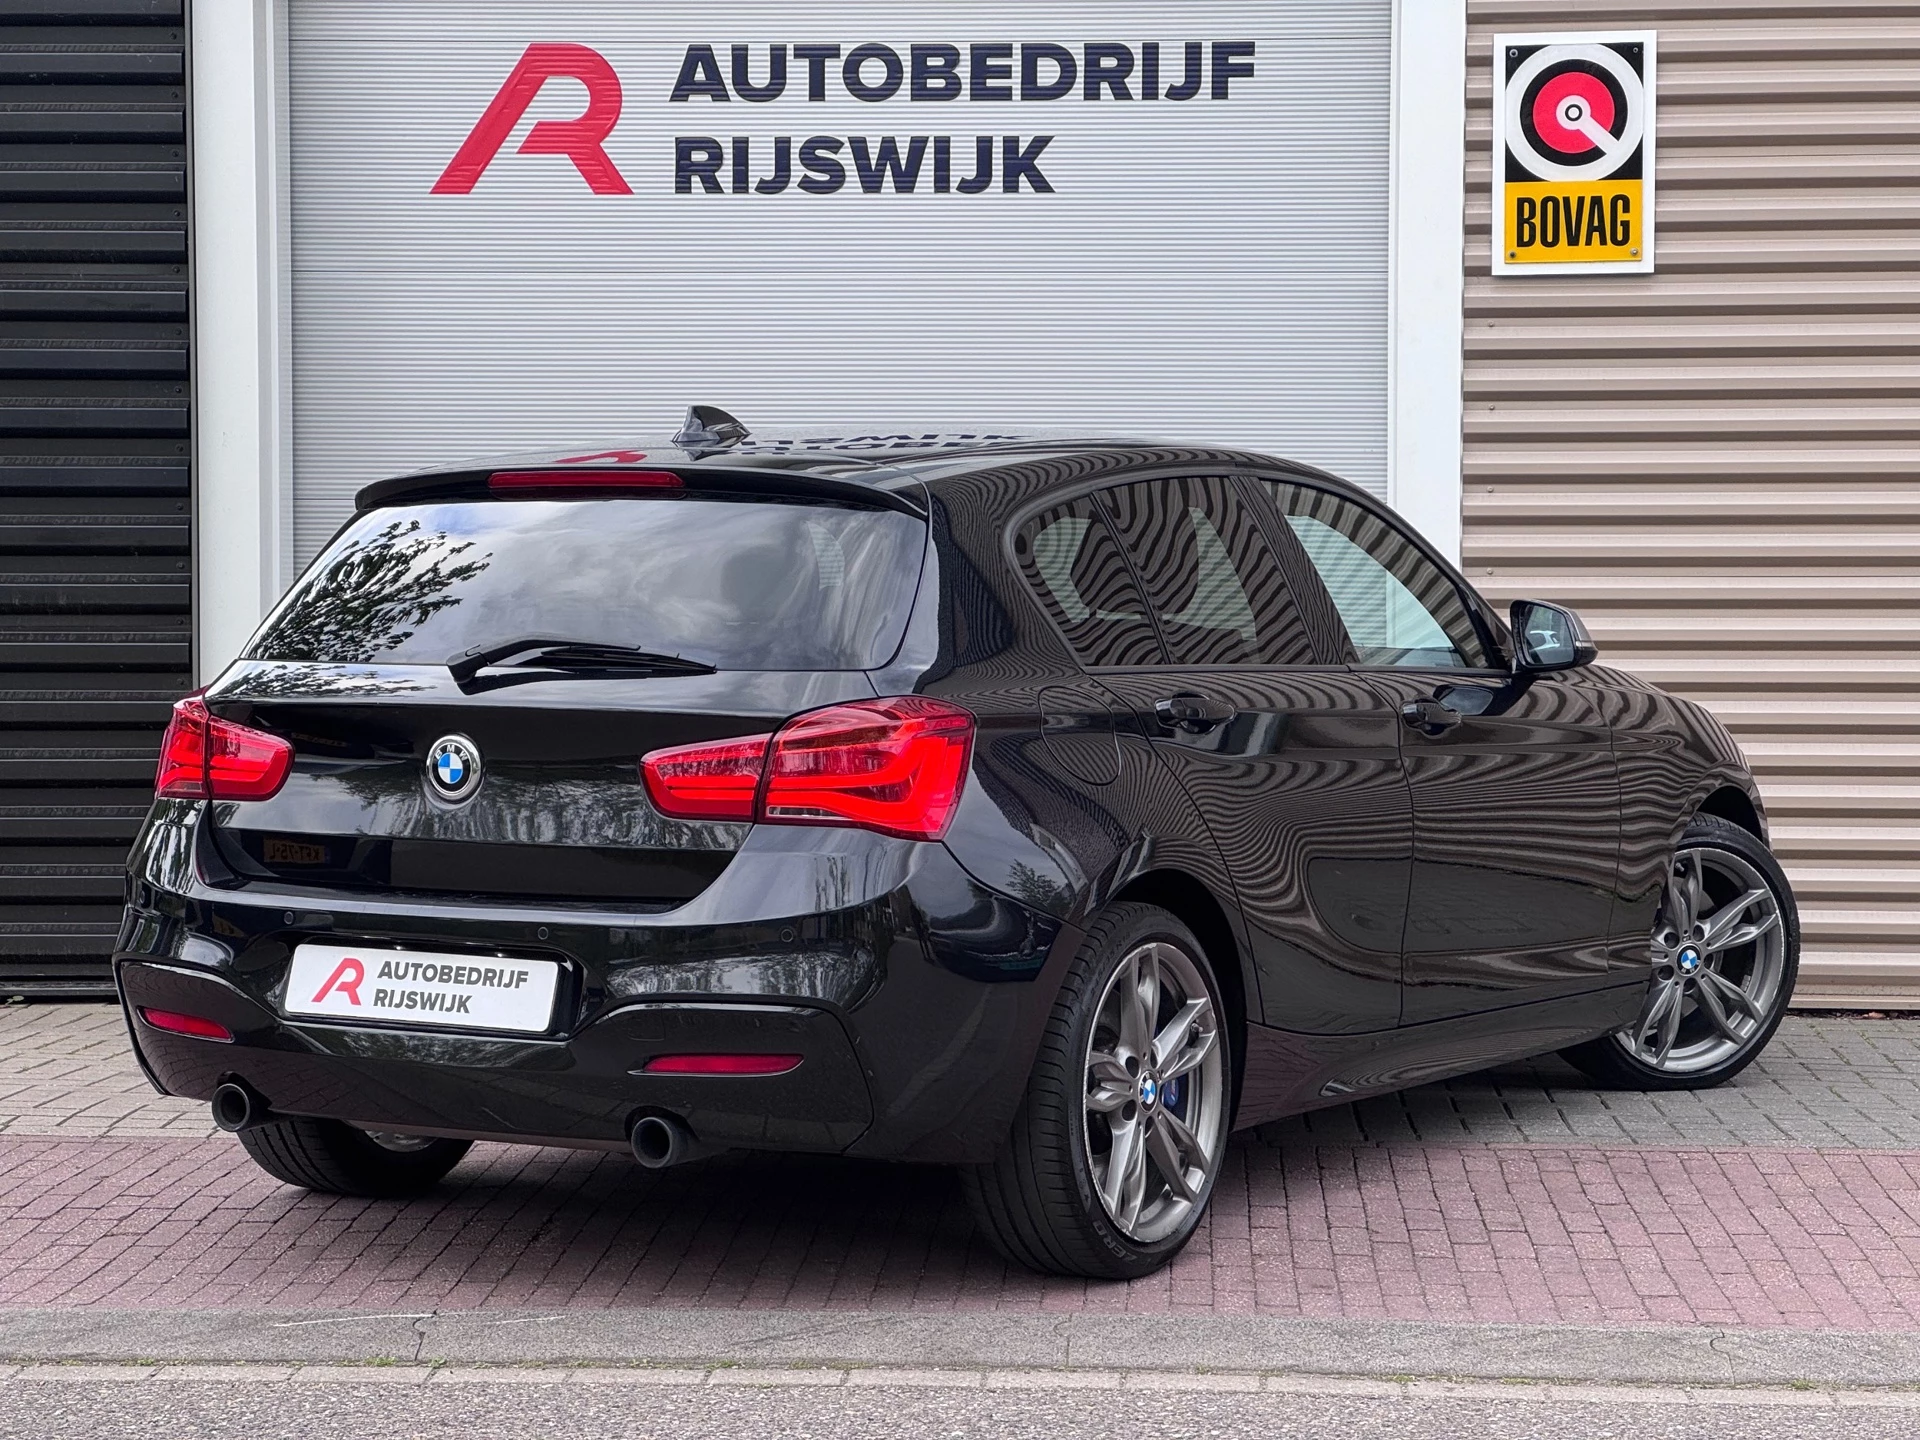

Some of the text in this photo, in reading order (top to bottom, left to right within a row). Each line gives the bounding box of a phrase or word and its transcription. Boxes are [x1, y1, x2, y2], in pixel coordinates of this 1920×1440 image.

[670, 42, 1255, 102] AUTOBEDRIJF
[674, 136, 1055, 194] RIJSWIJK
[1516, 194, 1630, 248] BOVAG
[434, 744, 469, 761] BMW
[377, 960, 529, 989] AUTOBEDRIJF
[373, 988, 472, 1014] RIJSWIJK
